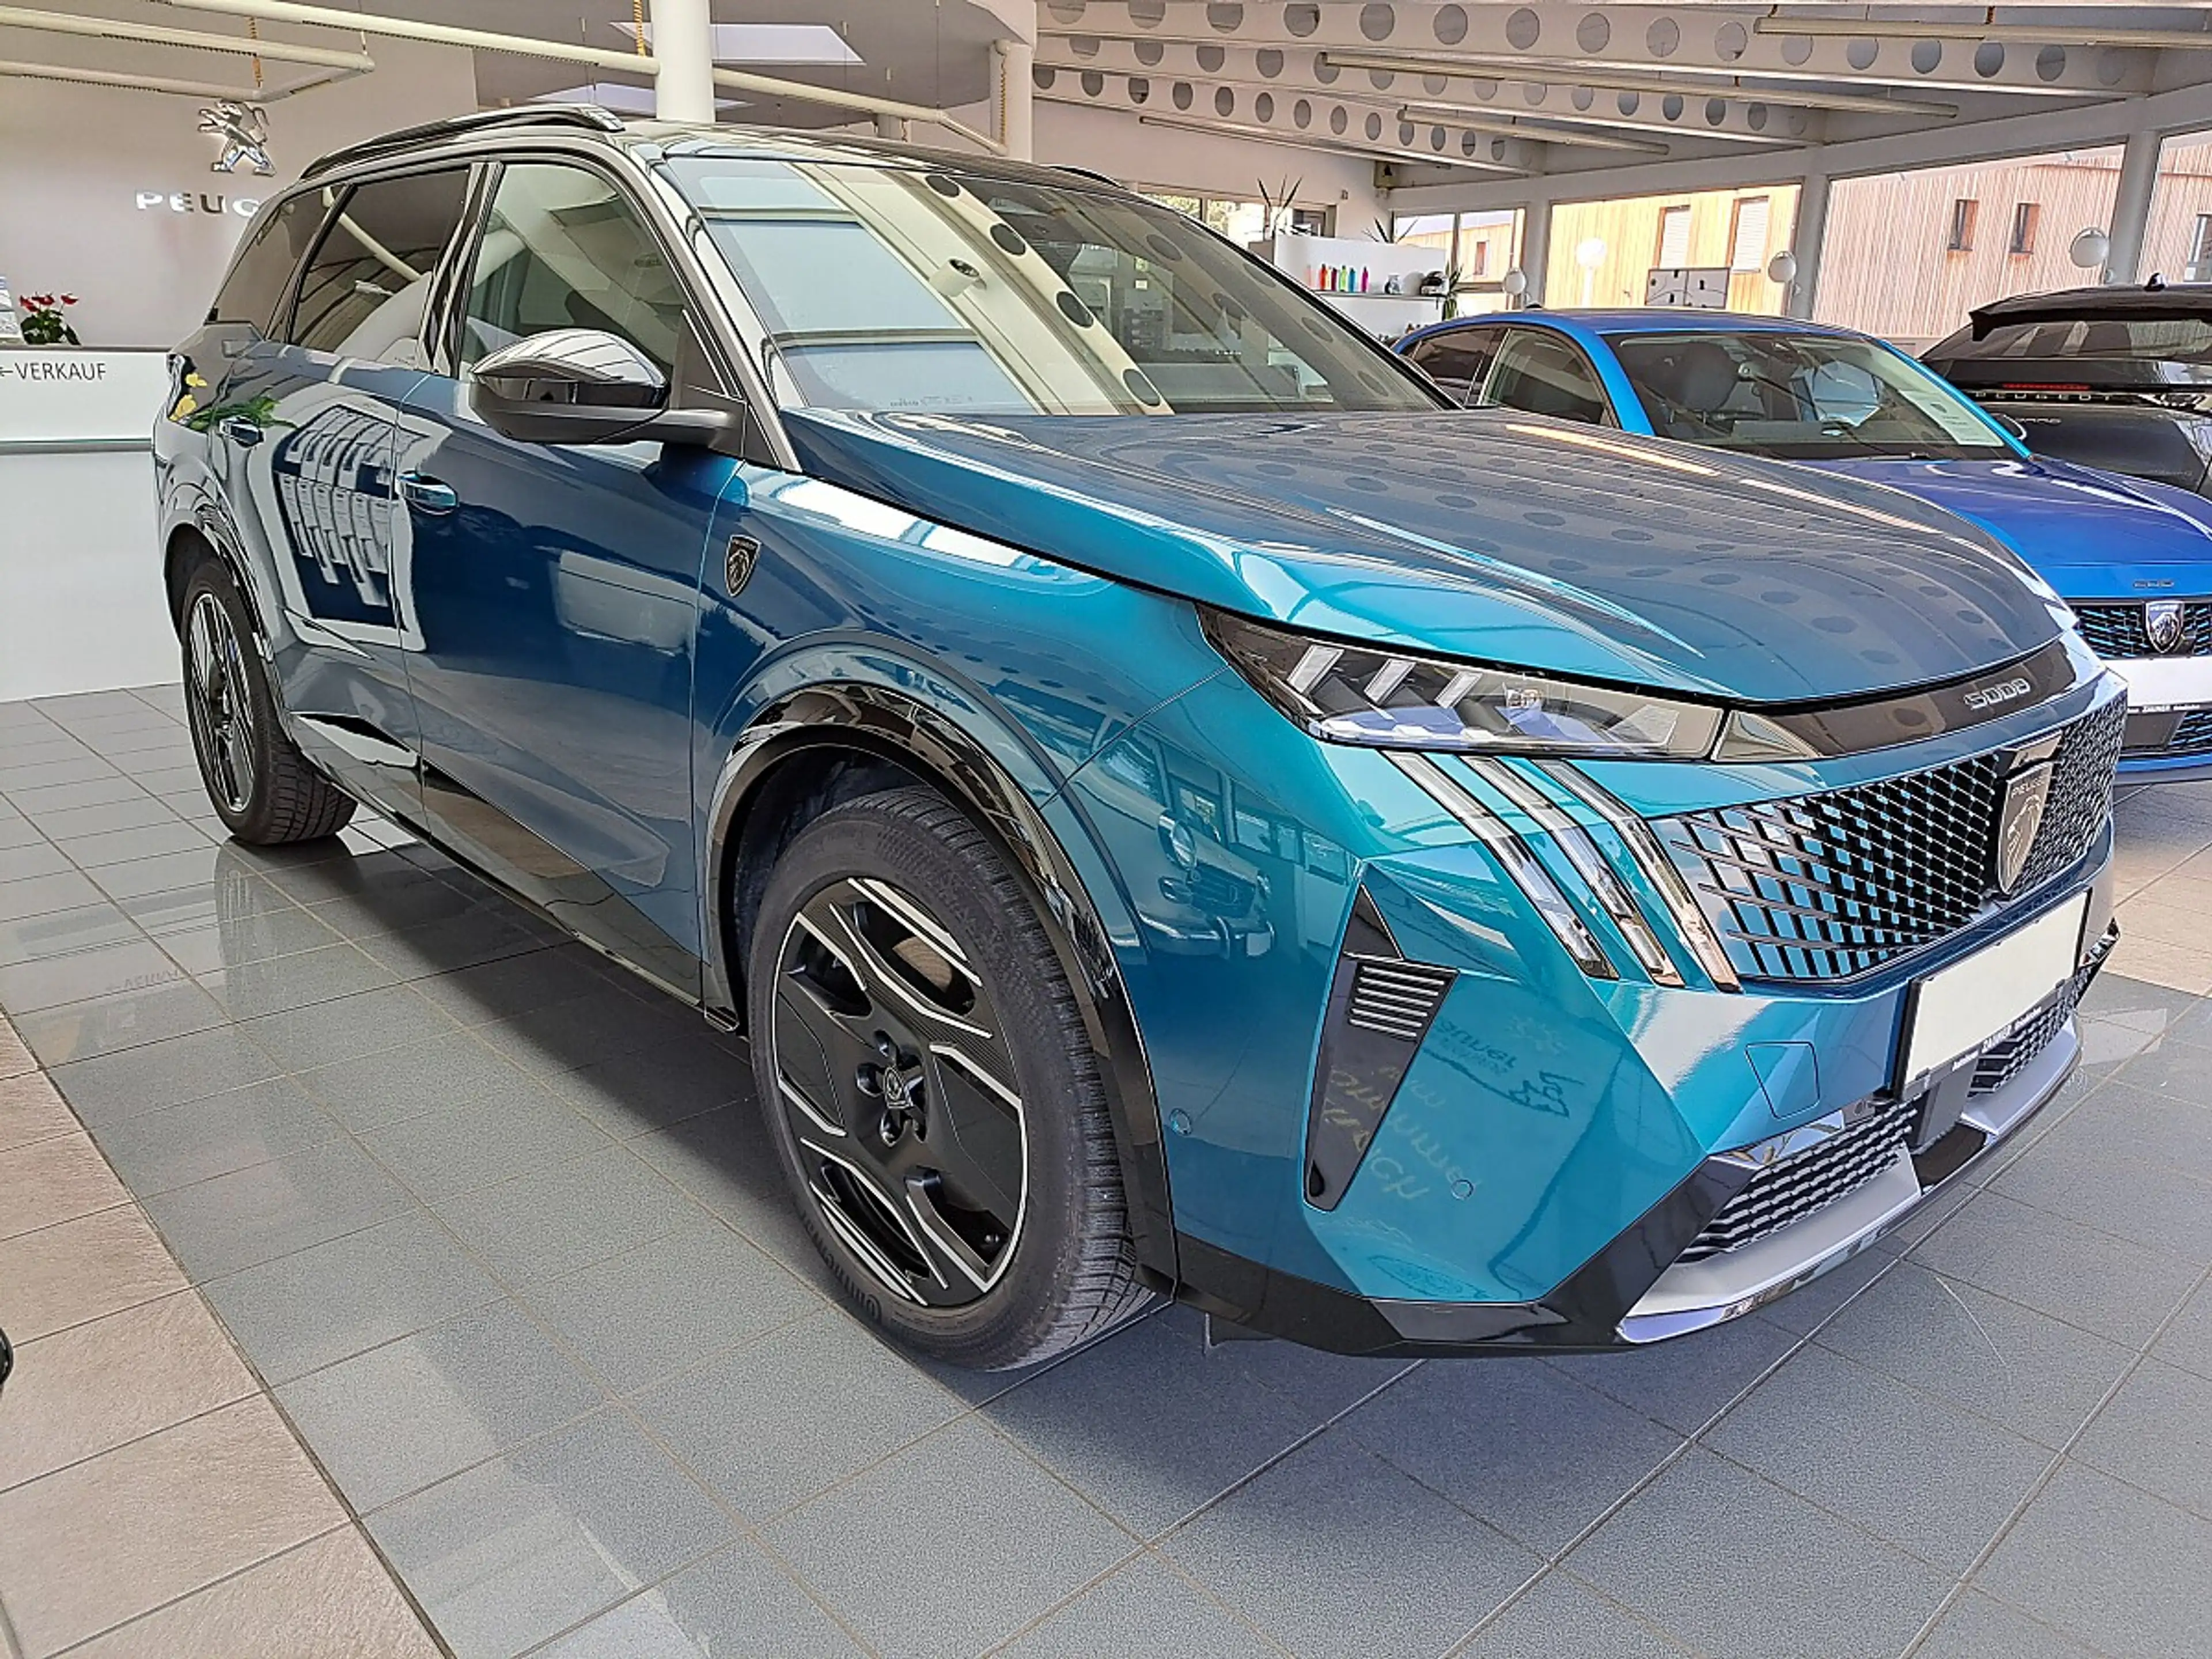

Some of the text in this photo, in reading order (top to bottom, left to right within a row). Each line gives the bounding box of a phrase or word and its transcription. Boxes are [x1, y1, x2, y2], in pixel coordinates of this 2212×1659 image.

[135, 191, 259, 217] PEUG
[14, 362, 107, 380] VERKAUF
[1964, 678, 2031, 710] 5008
